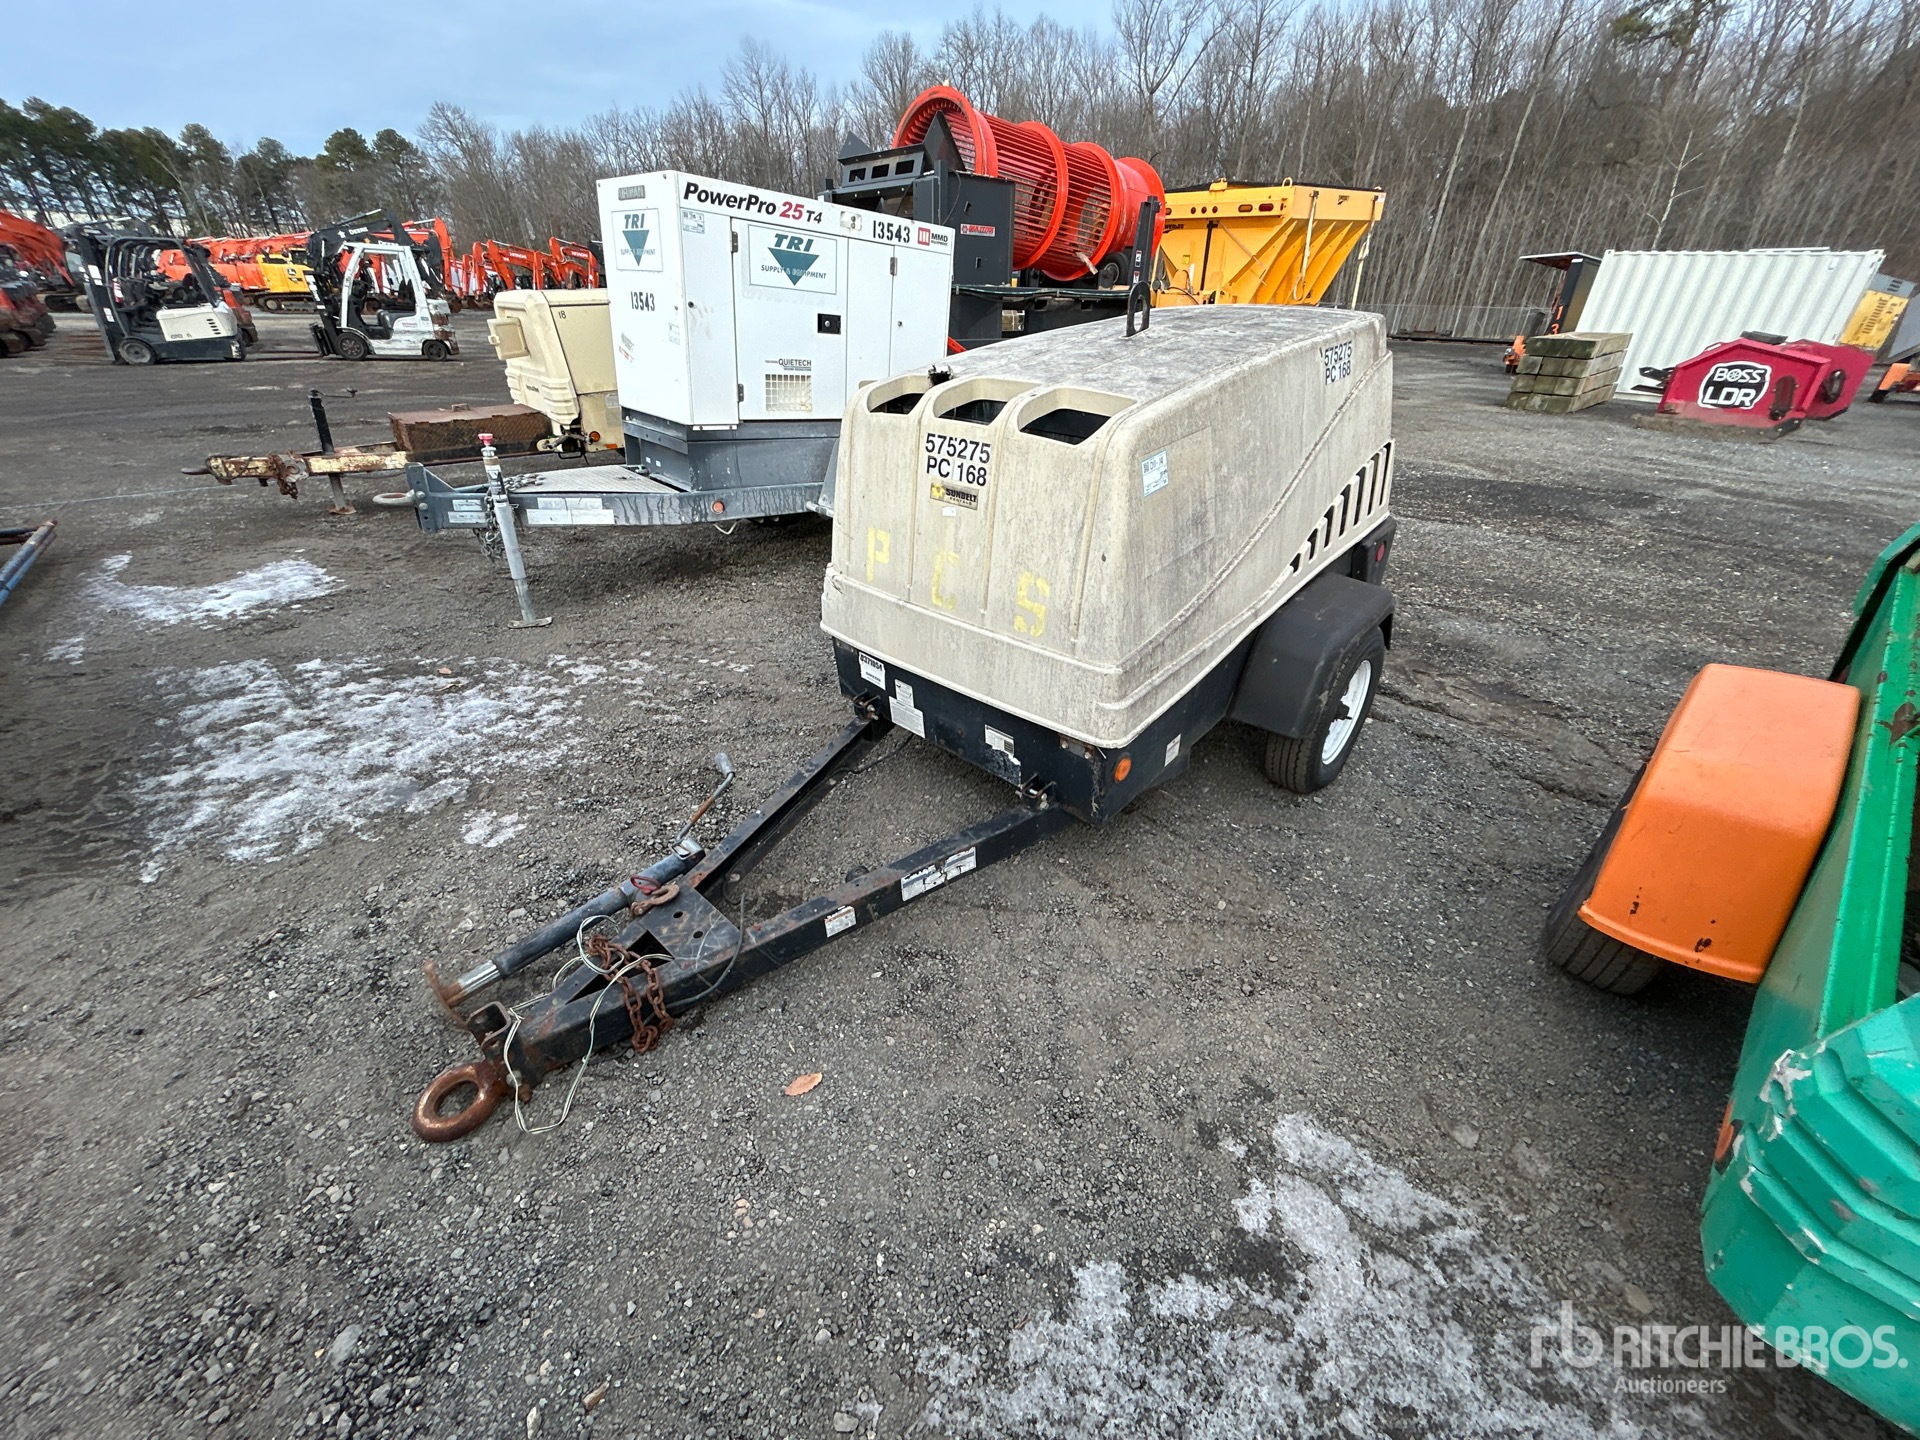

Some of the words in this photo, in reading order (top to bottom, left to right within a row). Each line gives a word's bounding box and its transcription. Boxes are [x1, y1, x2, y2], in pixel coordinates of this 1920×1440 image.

[683, 182, 777, 216] PowerPro
[779, 201, 805, 220] 25
[806, 210, 823, 224] T4
[624, 213, 645, 229] TRI
[872, 219, 911, 244] 13543
[931, 232, 948, 242] MMD
[774, 233, 814, 252] TRI
[761, 264, 785, 274] SUPPLY
[630, 291, 655, 311] 13543
[778, 358, 812, 367] QUIETECH
[1324, 340, 1352, 366] 575275
[1325, 365, 1336, 385] PC
[1338, 360, 1351, 379] 168
[1713, 367, 1765, 384] BOSS
[1702, 386, 1757, 407] LDR
[925, 432, 992, 464] 575275
[926, 455, 951, 478] PC
[957, 462, 987, 487] 168
[945, 488, 977, 503] SUNBELT
[866, 527, 891, 582] P
[1013, 571, 1051, 638] S
